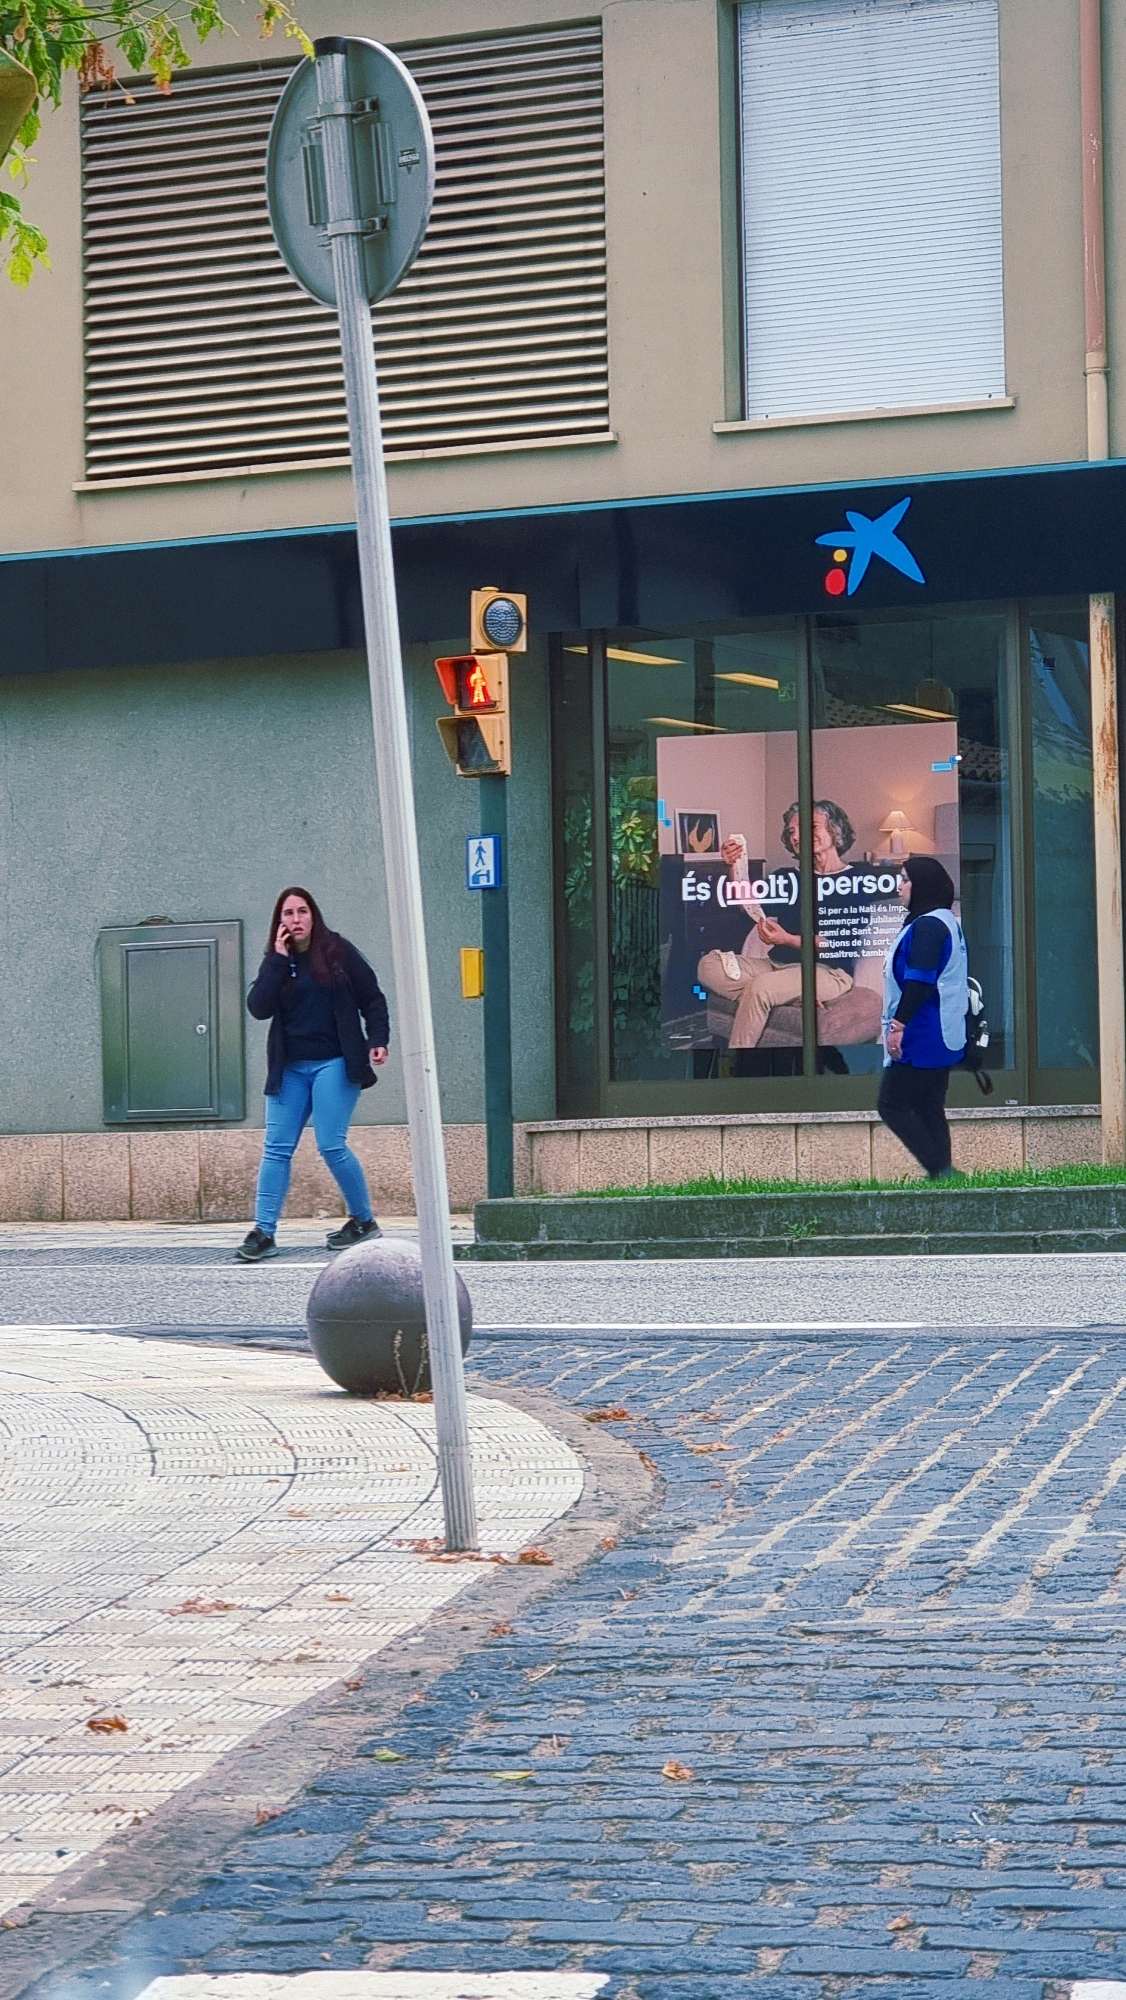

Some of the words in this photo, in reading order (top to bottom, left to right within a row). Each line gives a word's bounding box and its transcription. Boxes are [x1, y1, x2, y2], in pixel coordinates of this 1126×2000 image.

[682, 871, 711, 901] És
[717, 873, 798, 907] (molt)
[828, 907, 842, 916] per
[850, 906, 858, 914] la
[859, 905, 876, 913] Nati
[870, 915, 905, 925] jubilació
[819, 928, 839, 936] camí
[852, 927, 872, 935] Sant
[819, 940, 850, 948] mitjons
[819, 950, 860, 958] nosaltres,
